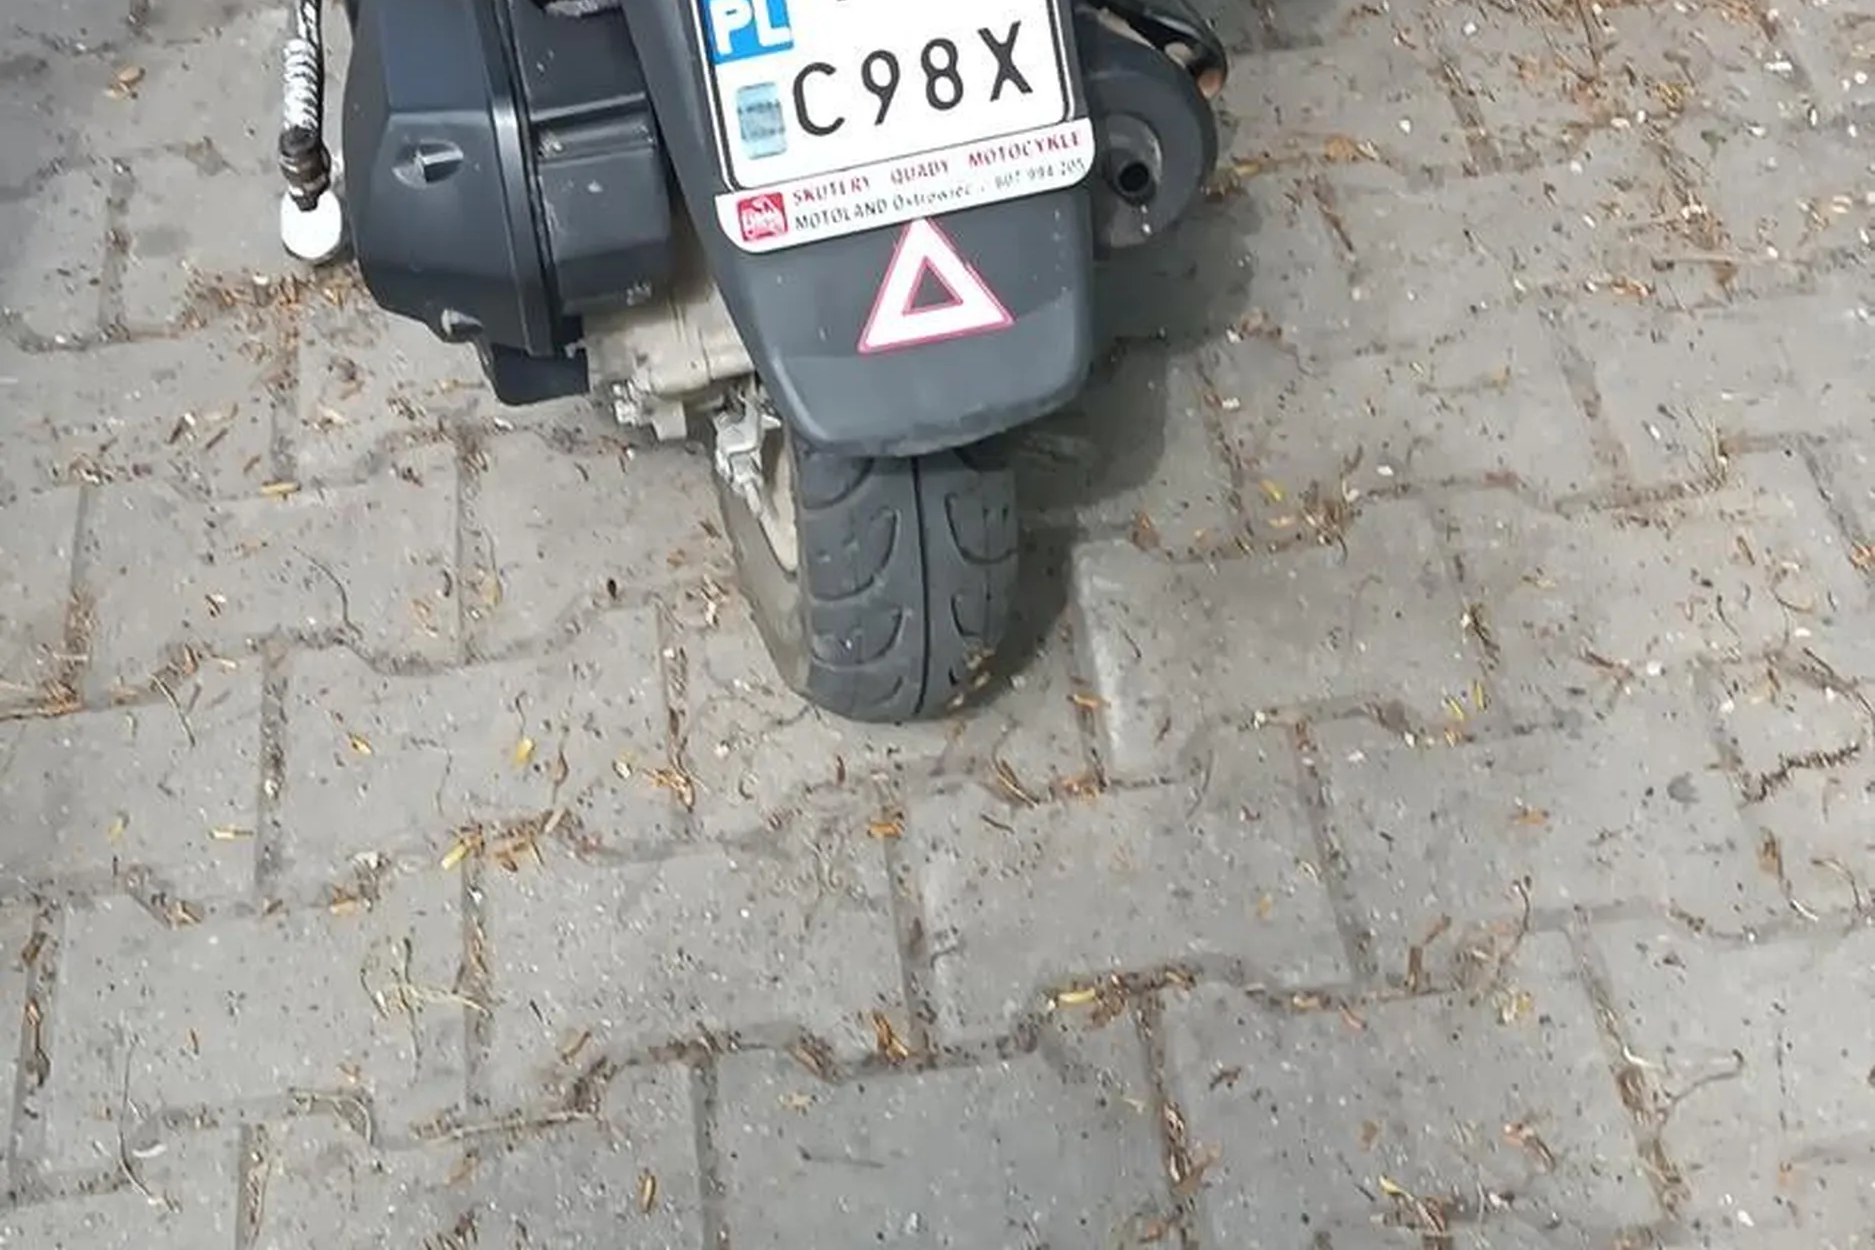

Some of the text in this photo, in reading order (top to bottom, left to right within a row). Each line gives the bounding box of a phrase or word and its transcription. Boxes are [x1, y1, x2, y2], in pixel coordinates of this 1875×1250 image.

[792, 20, 1034, 137] C98X
[792, 131, 1081, 207] SKUTERY QUADY MOTOCYKLE
[795, 198, 888, 231] MOTOLAND
